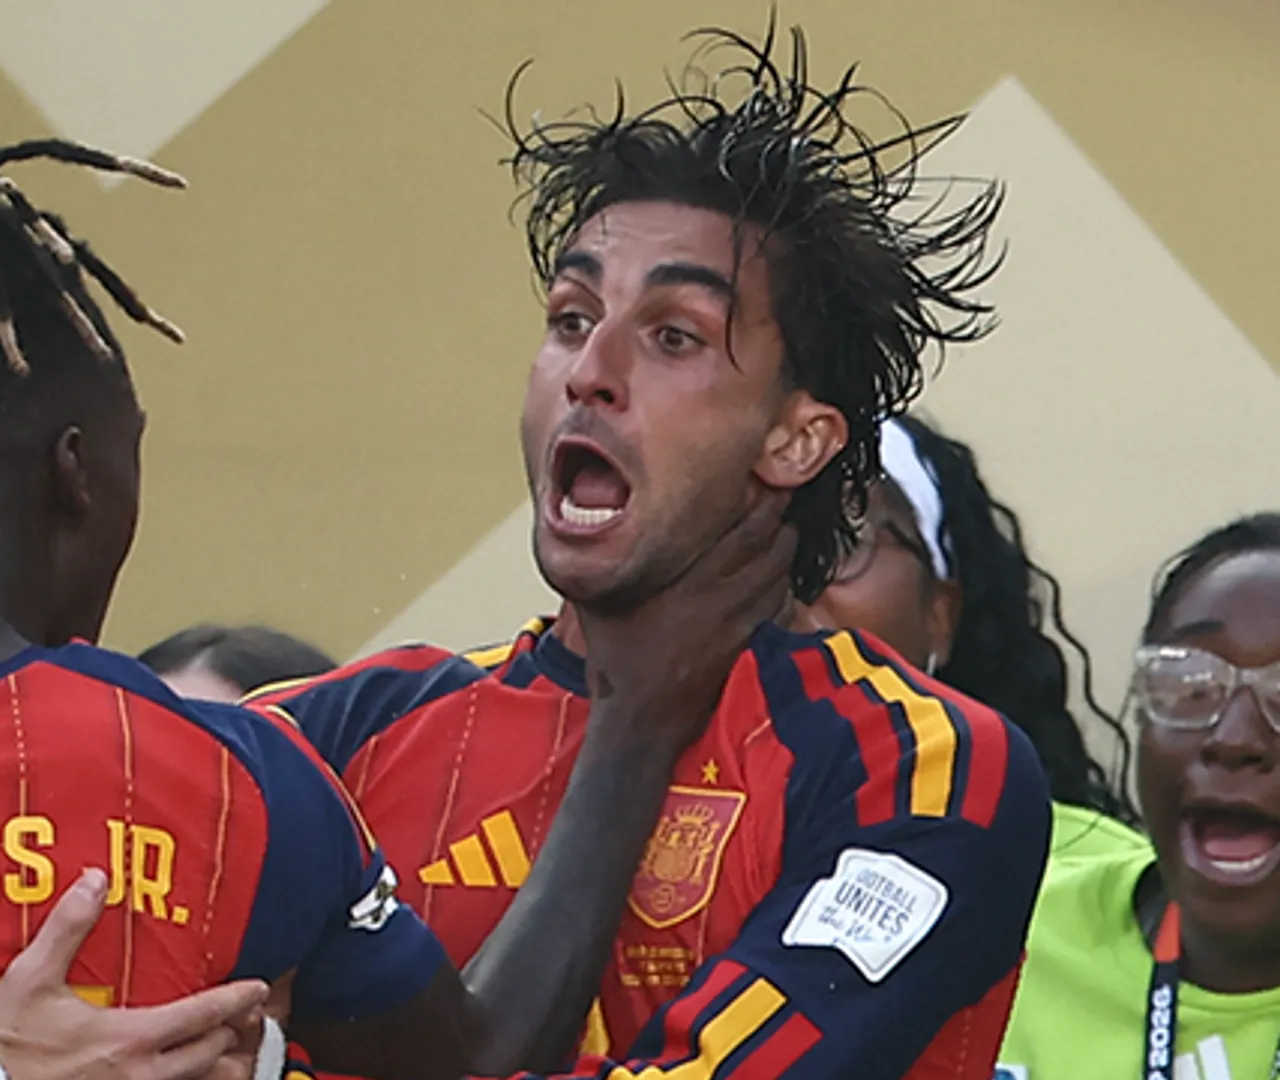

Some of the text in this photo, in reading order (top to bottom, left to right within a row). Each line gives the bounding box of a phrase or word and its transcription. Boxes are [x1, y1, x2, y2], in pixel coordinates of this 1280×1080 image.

[102, 818, 190, 925] JR.
[835, 881, 910, 936] UNITES
[1148, 985, 1172, 1069] 2026
